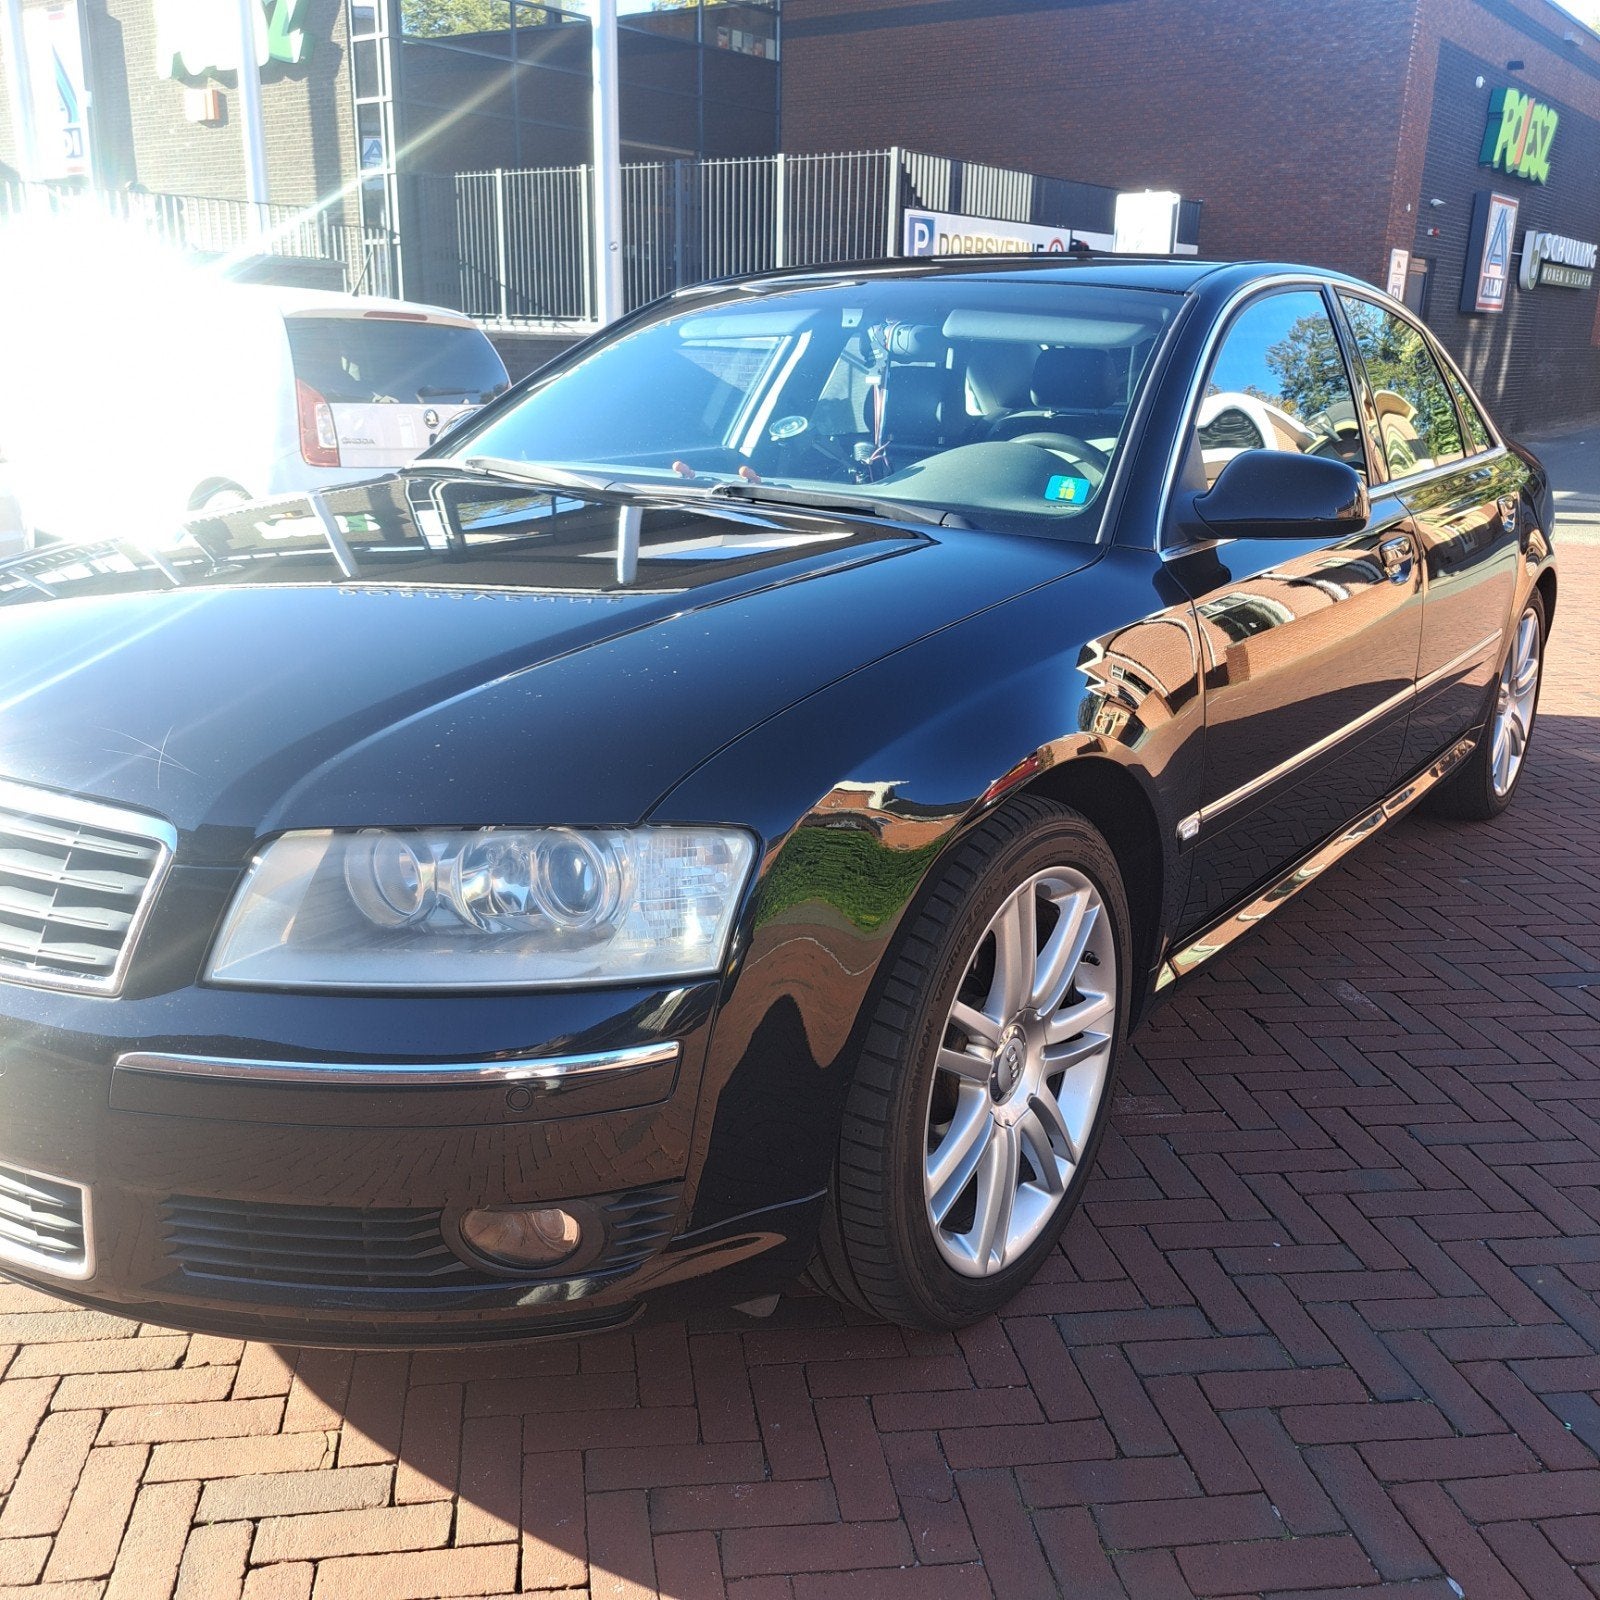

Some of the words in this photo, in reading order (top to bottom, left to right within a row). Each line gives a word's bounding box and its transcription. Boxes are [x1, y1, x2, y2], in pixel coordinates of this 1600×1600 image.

[1493, 88, 1559, 185] POIESZ
[914, 222, 929, 255] P
[1541, 233, 1598, 269] SCHUILING
[1482, 278, 1503, 297] ALDI
[1542, 267, 1564, 283] WONEN
